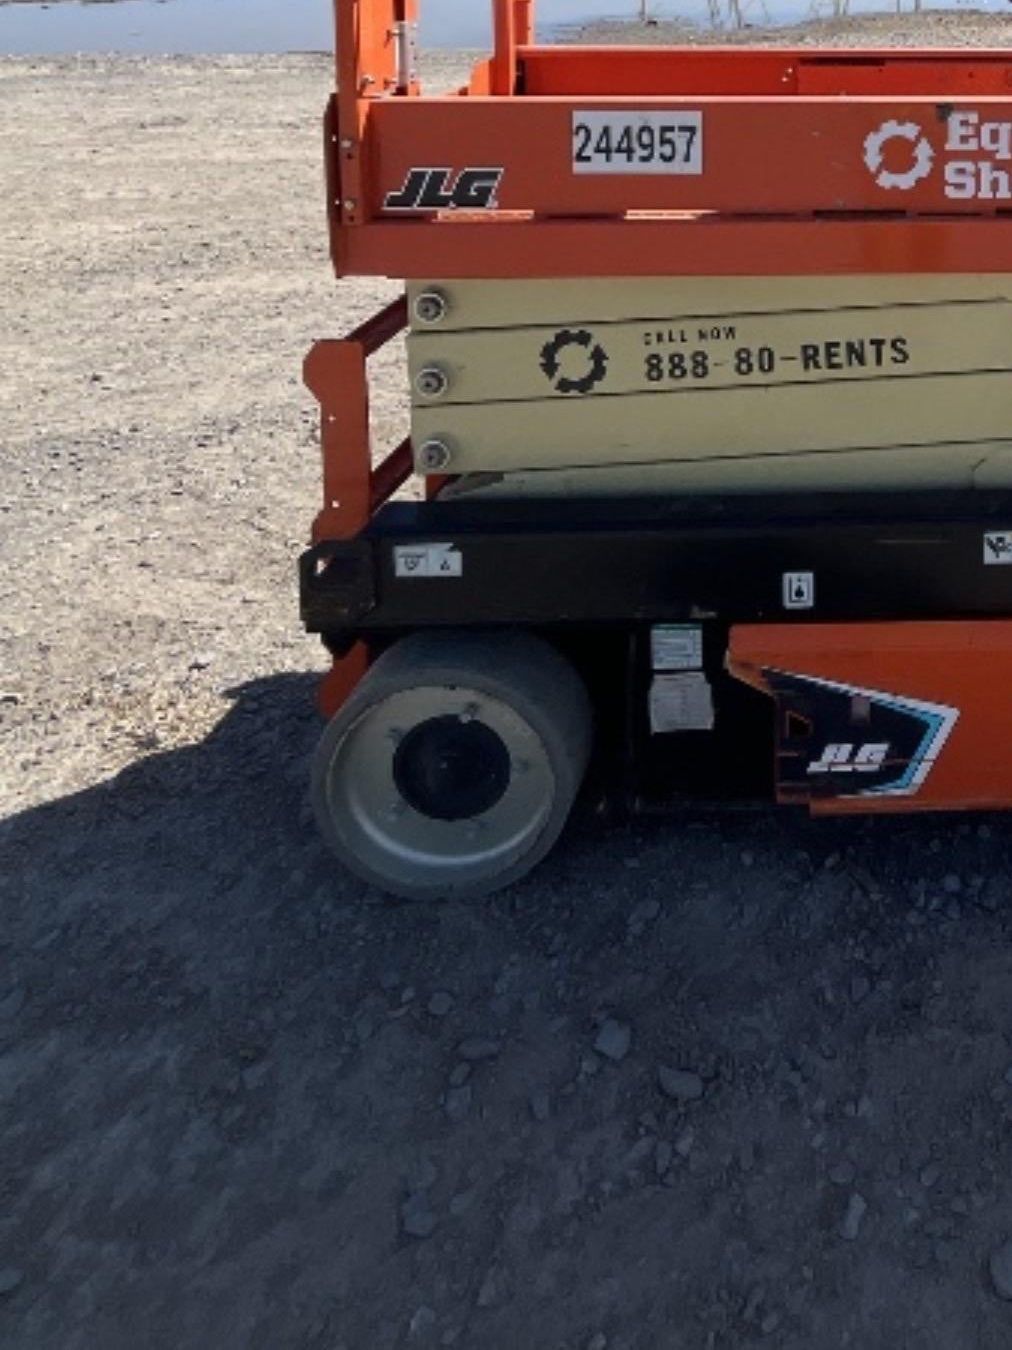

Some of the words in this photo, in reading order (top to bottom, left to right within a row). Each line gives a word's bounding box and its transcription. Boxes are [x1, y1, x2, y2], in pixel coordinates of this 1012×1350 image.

[574, 124, 697, 163] 244957
[382, 168, 502, 210] JLG
[699, 327, 736, 340] NOW
